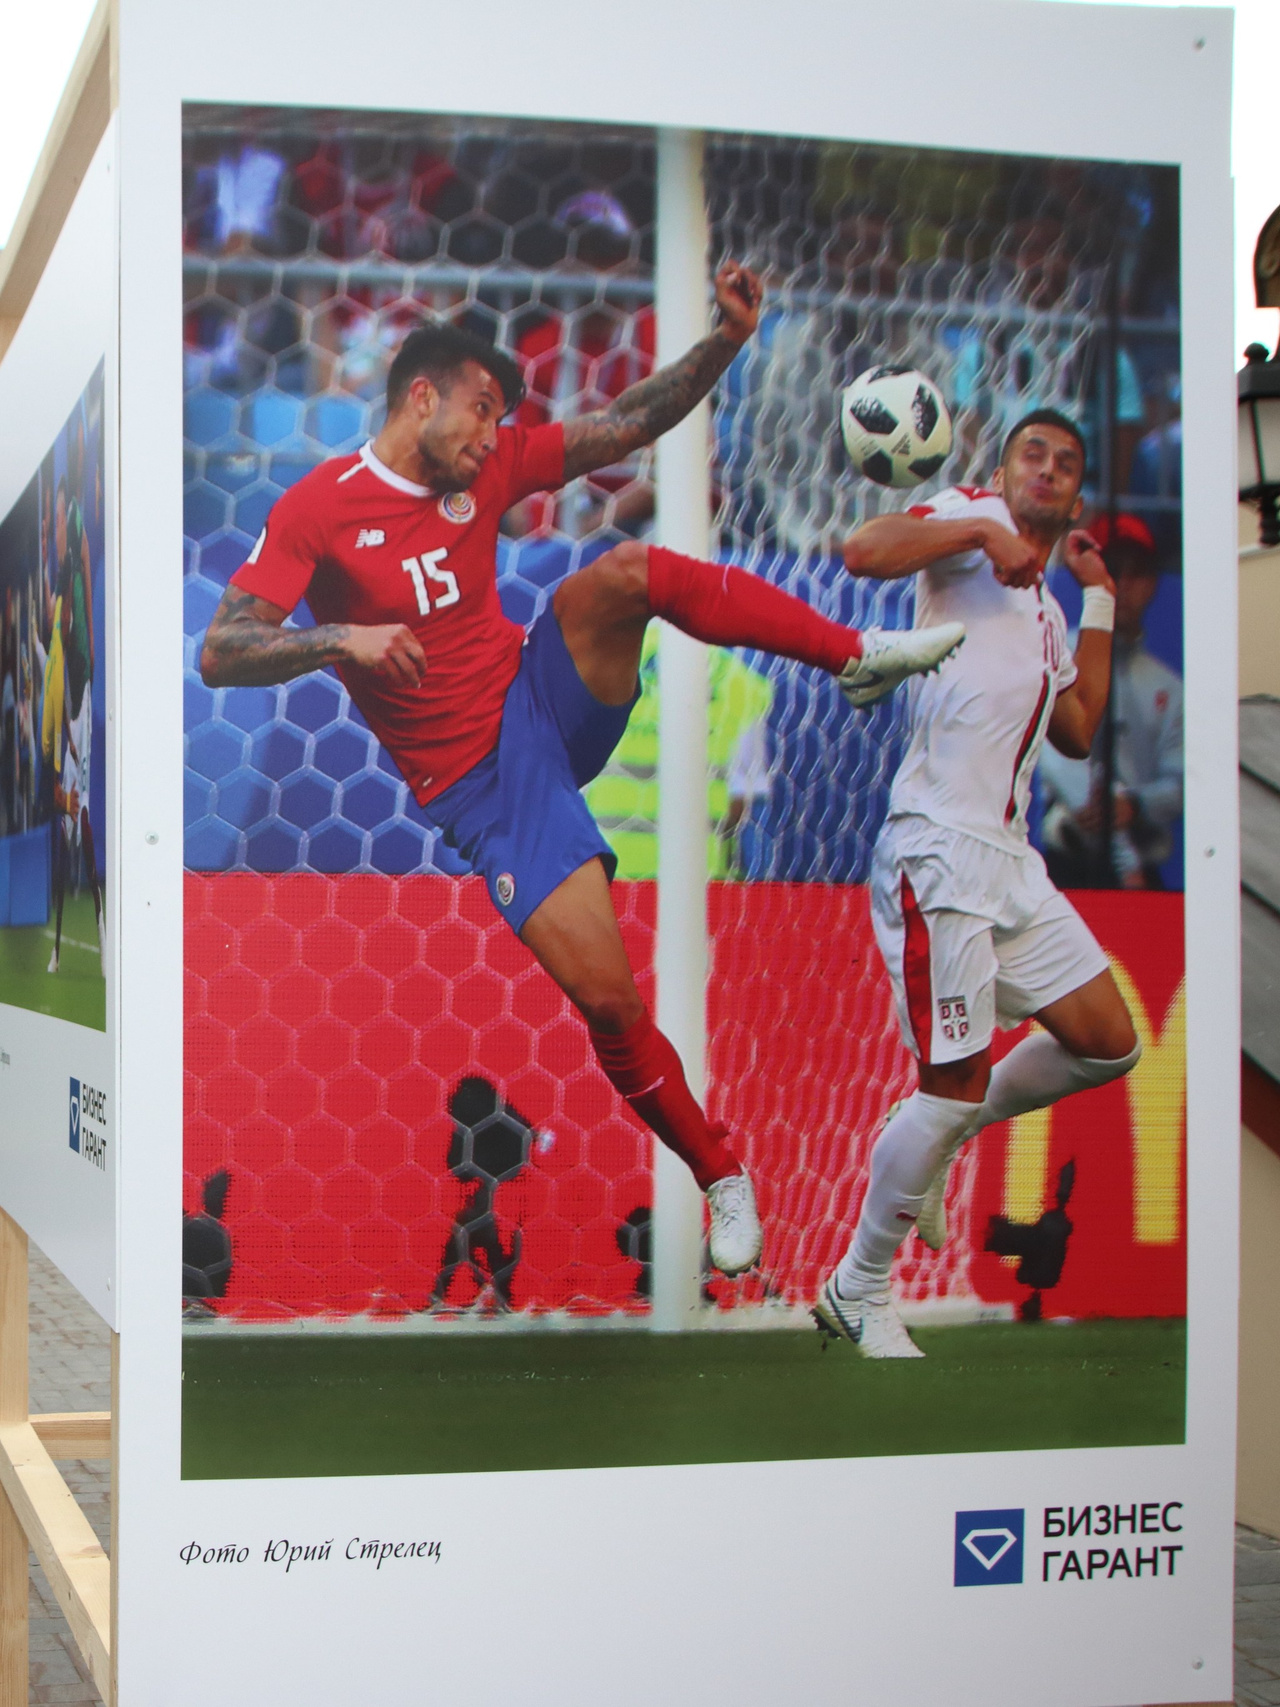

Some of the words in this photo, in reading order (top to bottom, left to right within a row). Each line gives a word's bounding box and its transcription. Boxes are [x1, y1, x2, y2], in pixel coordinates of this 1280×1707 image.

[401, 546, 461, 616] 15
[82, 1083, 107, 1126] БИЗНЕС
[81, 1127, 107, 1172] ГАРАНТ
[1043, 1501, 1184, 1538] БИЗНЕС
[179, 1540, 250, 1566] Фото
[263, 1538, 335, 1574] Юрий
[345, 1536, 442, 1571] Стрелец
[1042, 1544, 1184, 1582] ГАРАНТ
